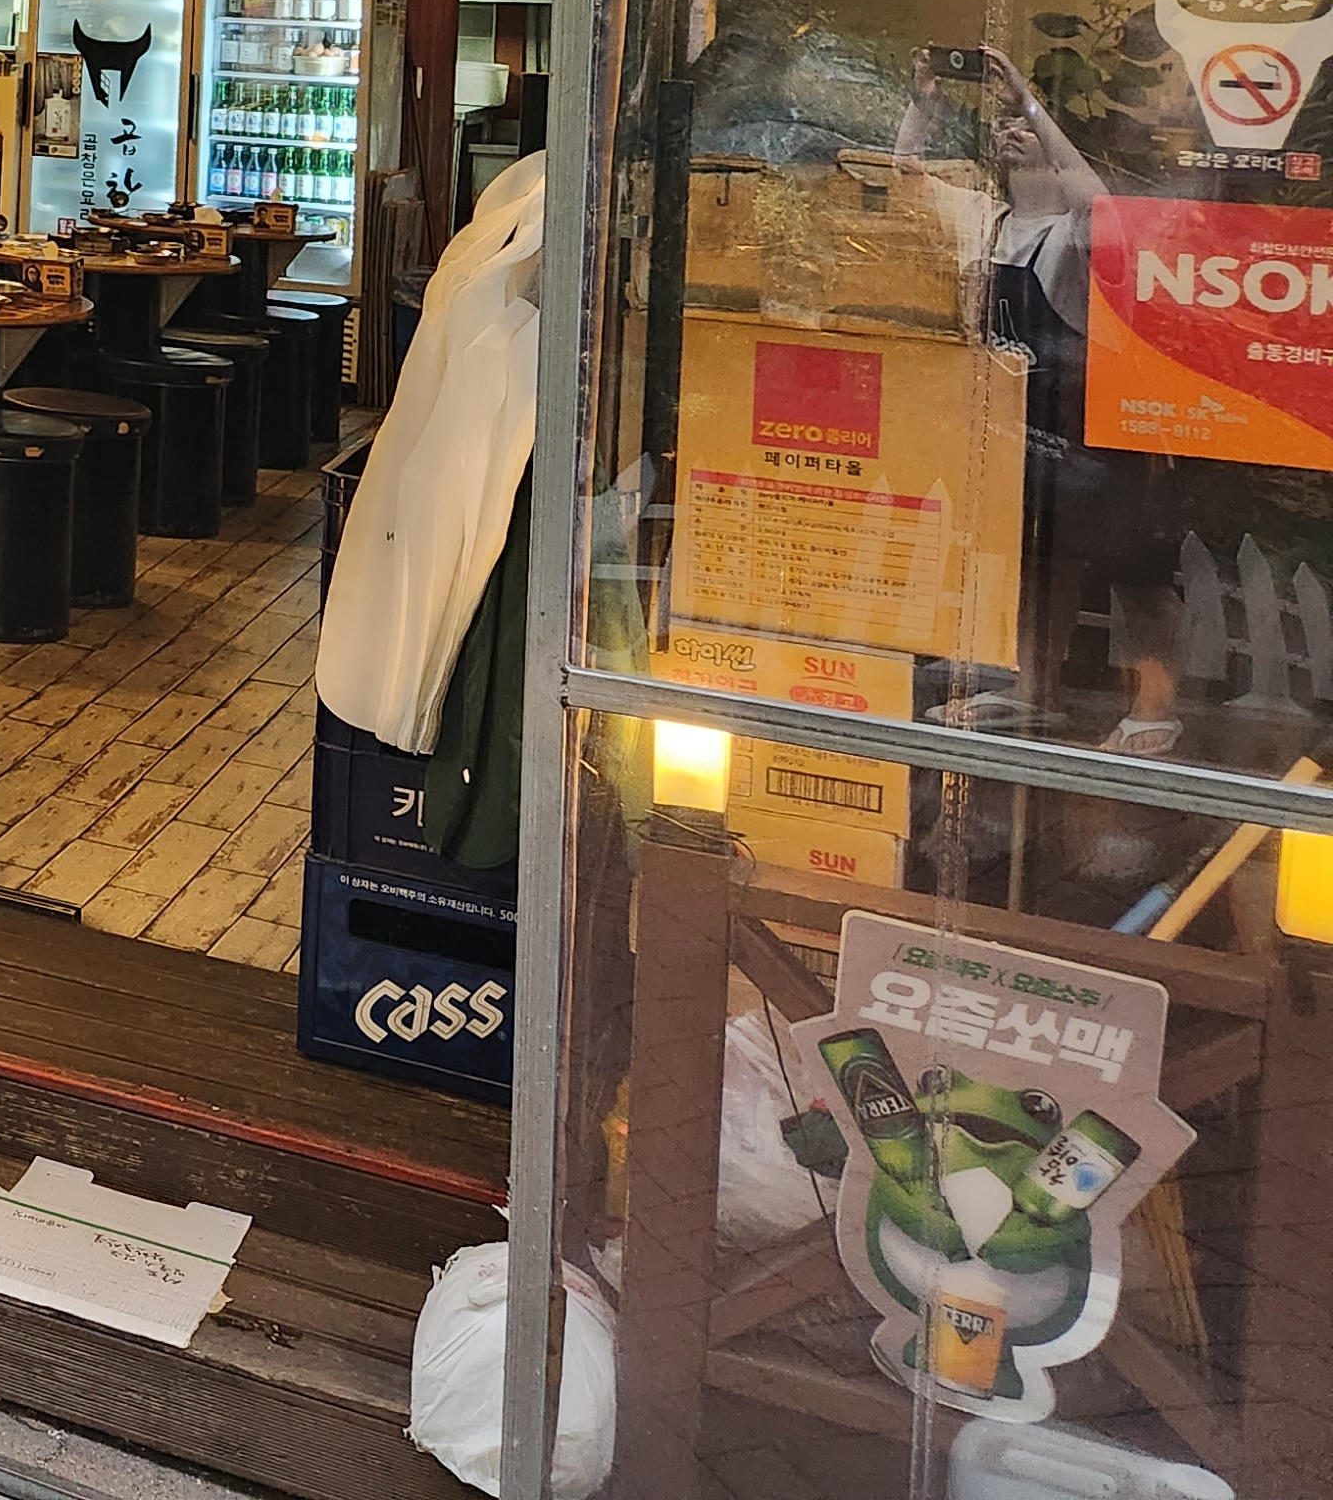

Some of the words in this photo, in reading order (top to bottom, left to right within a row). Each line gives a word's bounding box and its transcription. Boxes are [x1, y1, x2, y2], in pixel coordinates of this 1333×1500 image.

[764, 451, 863, 477] 페이퍼타올
[803, 656, 856, 681] SUN
[809, 849, 856, 874] SUN
[351, 876, 379, 892] 상자는
[380, 883, 427, 903] 오비맥주의
